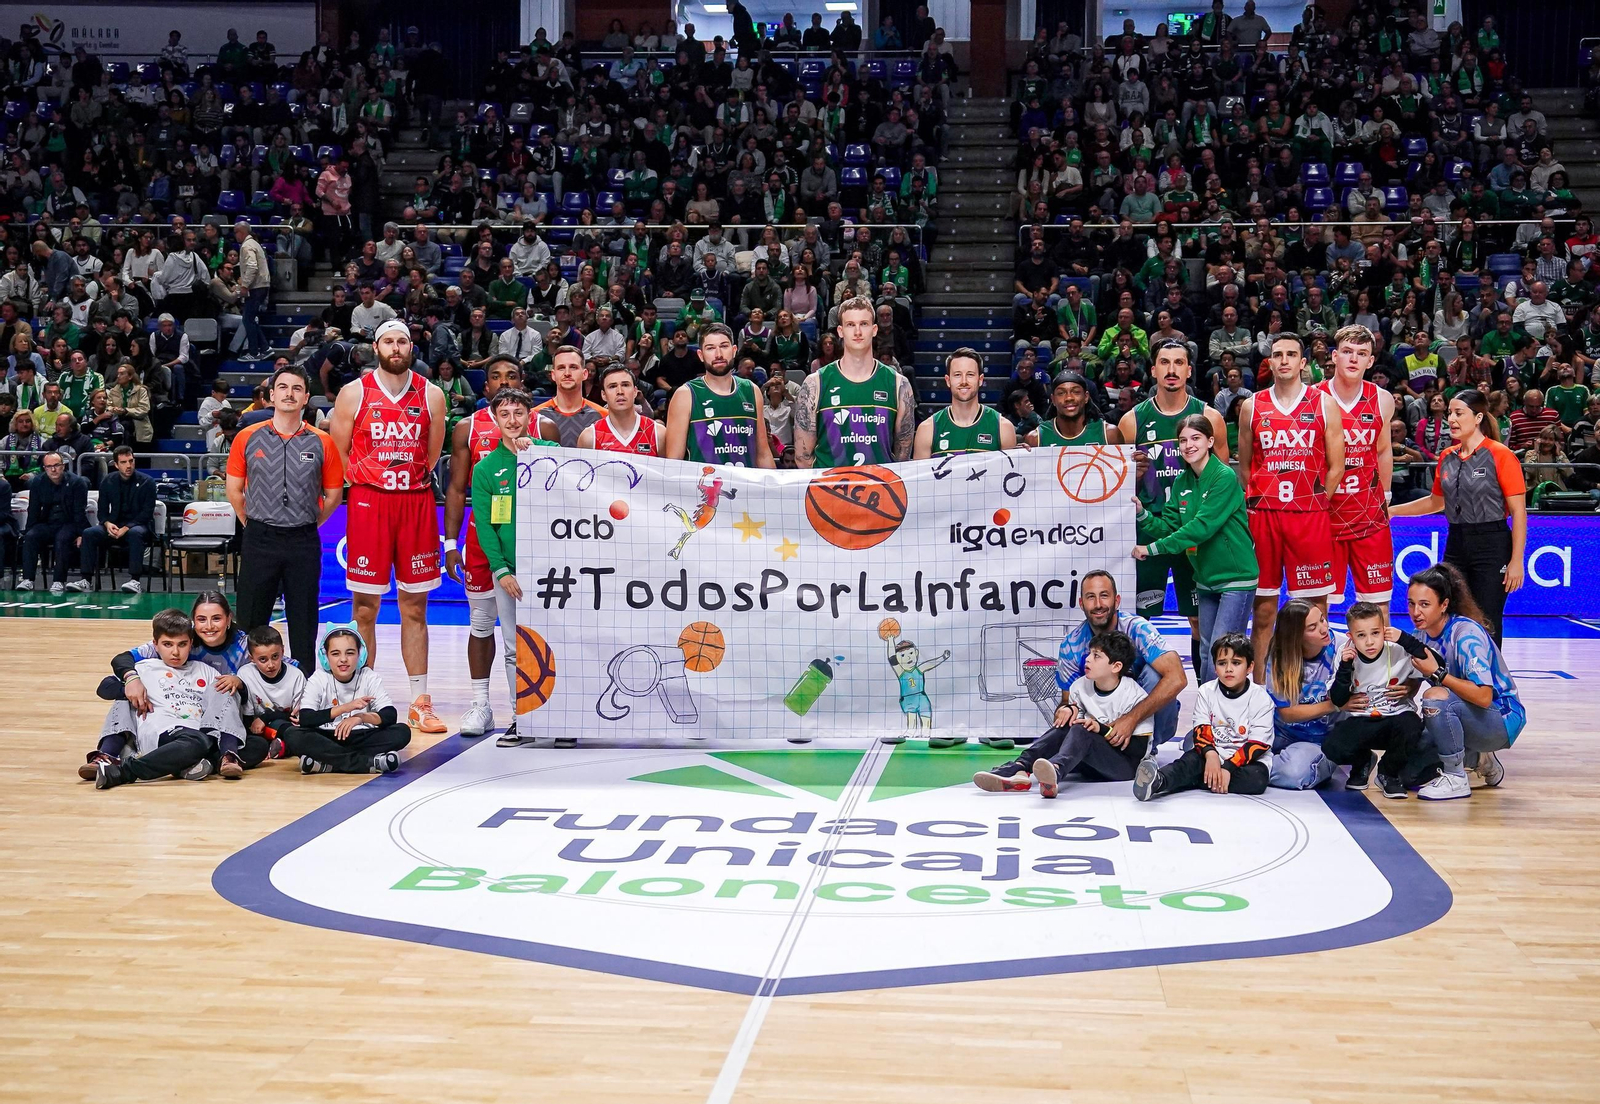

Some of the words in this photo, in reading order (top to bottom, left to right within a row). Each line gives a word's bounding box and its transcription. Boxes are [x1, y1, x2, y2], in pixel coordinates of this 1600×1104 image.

[72, 26, 119, 38] MÁLAGA
[851, 413, 886, 425] Unicaja
[370, 422, 421, 440] BAXI
[1259, 429, 1316, 449] BAXI
[378, 452, 414, 461] MANRESA
[853, 452, 866, 466] 2
[1344, 457, 1364, 467] RESA
[1267, 460, 1306, 471] MANRESA
[383, 470, 411, 490] 33
[831, 478, 881, 510] ACB
[1278, 480, 1294, 502] 8
[550, 514, 615, 540] acb
[411, 560, 426, 569] ETL
[348, 566, 377, 577] unilabor
[411, 566, 435, 576] GLOBAL
[1296, 571, 1311, 580] ETL
[1367, 570, 1382, 579] ETL
[1297, 578, 1324, 587] GLOBAL
[1368, 577, 1391, 585] GLOBAL
[537, 566, 1078, 619] #TodosPorLaInfanci
[477, 806, 1214, 845] Fundación
[557, 838, 1116, 881] Unicaja
[388, 865, 1250, 912] Baloncesto
